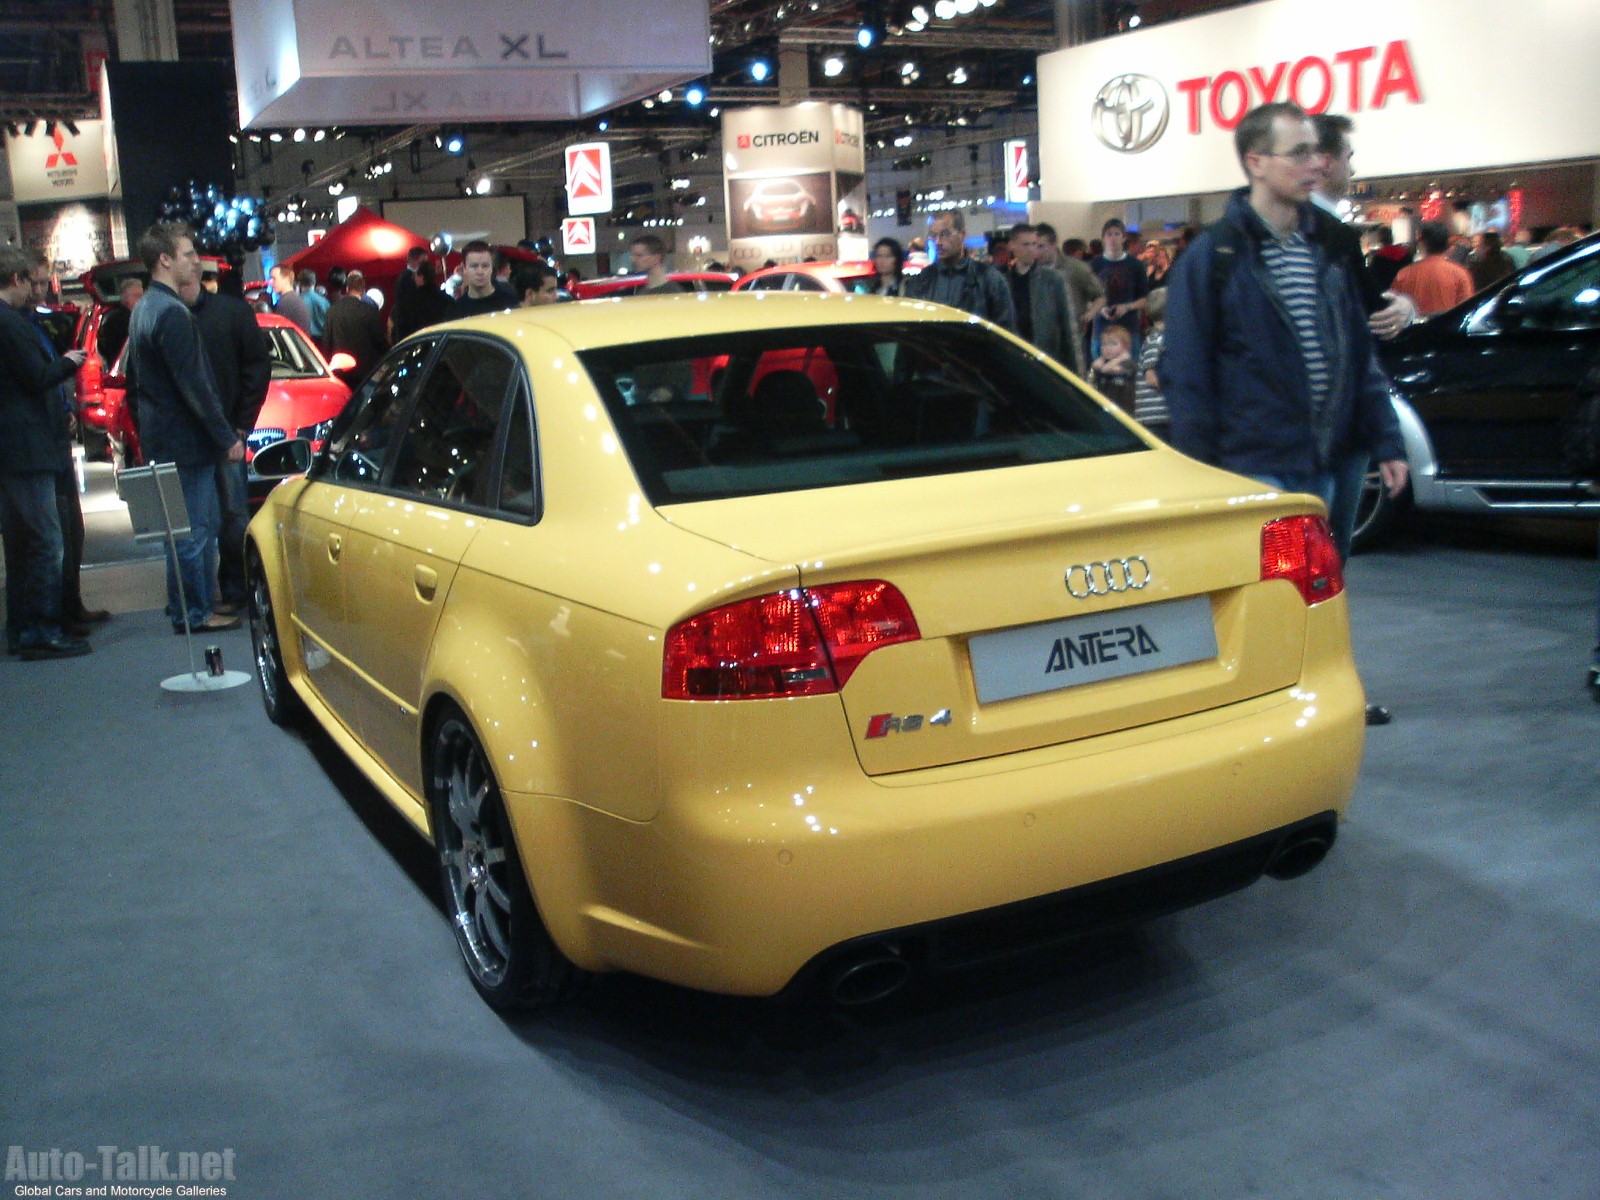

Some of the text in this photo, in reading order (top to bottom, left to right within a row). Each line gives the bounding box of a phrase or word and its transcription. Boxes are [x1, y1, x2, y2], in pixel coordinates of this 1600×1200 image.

[328, 33, 568, 60] ALTEA XL
[1177, 39, 1421, 134] TOYOTA
[753, 130, 819, 147] CITROËN
[1045, 624, 1160, 673] ANTERA
